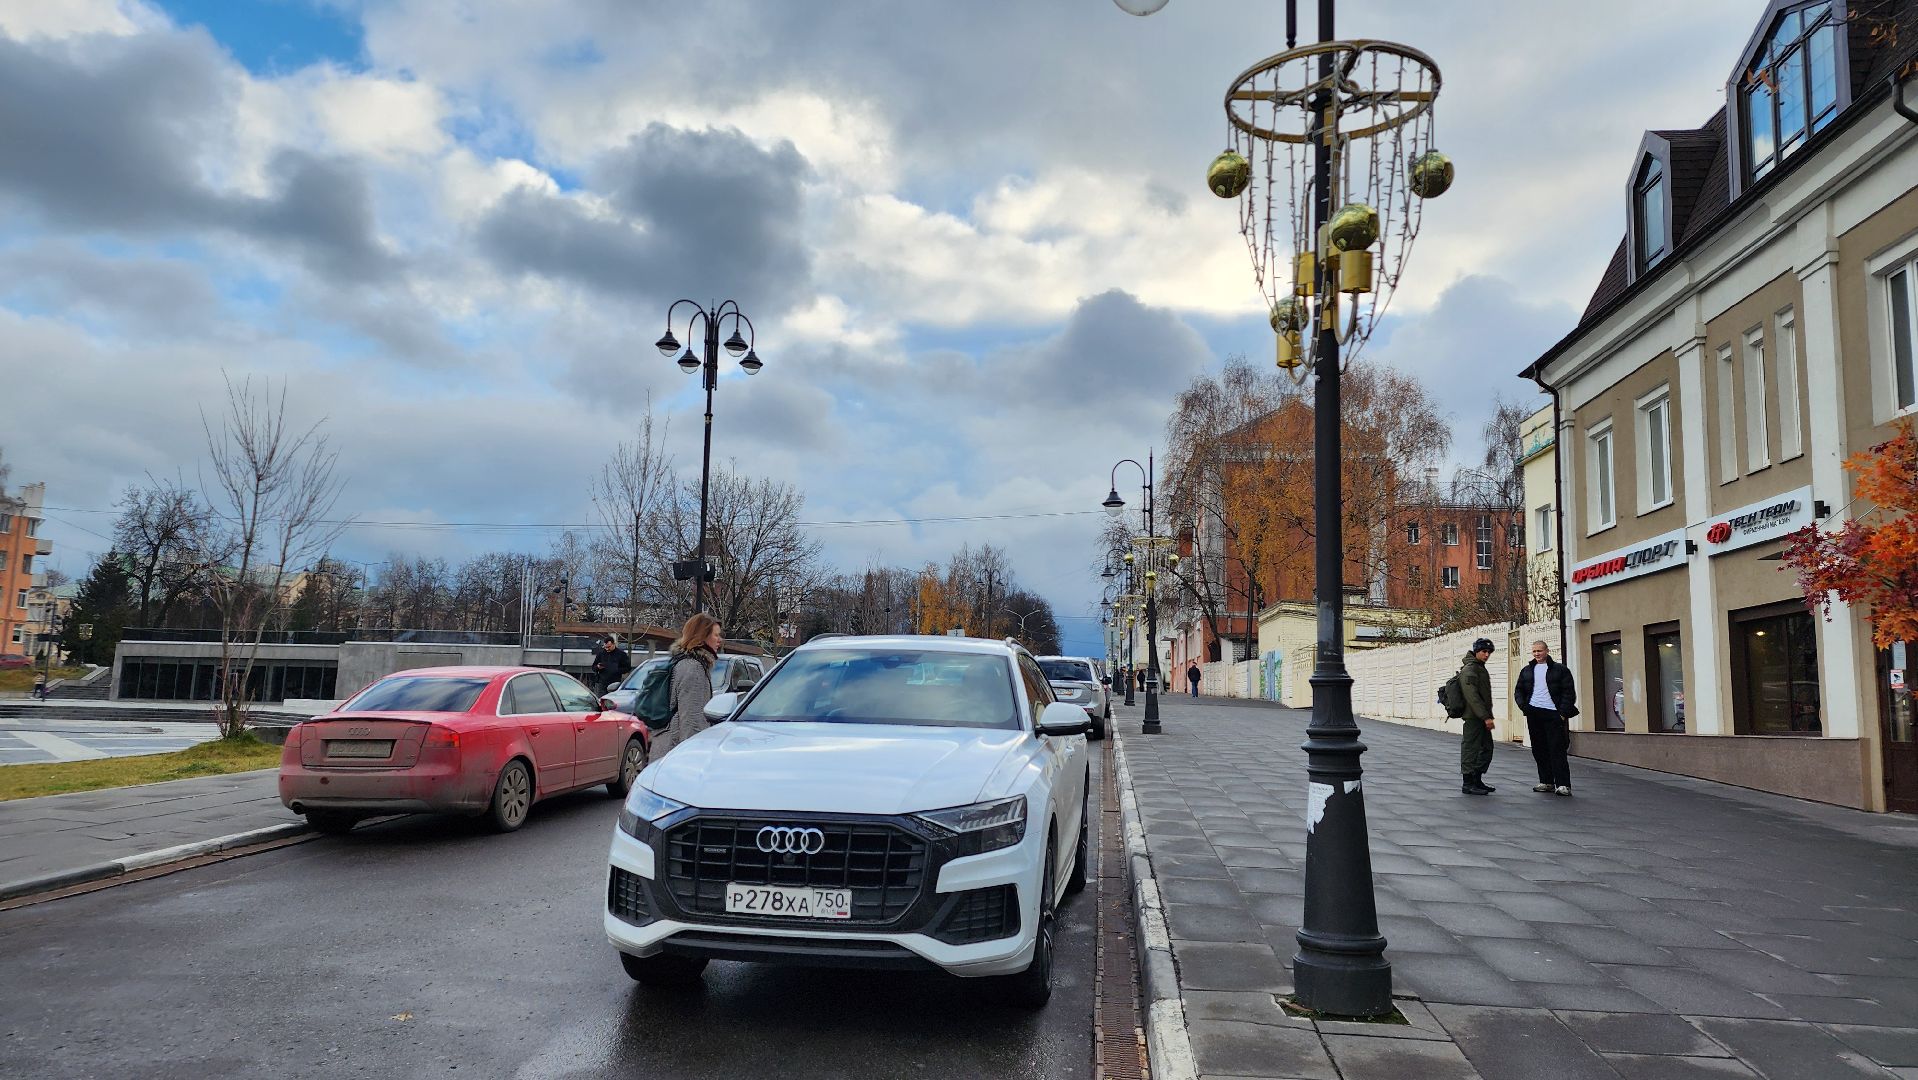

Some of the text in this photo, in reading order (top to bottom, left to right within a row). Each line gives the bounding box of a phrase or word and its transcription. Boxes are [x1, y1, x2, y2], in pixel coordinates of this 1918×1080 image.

[1729, 499, 1796, 528] TECH TEAM
[815, 891, 844, 908] 750
